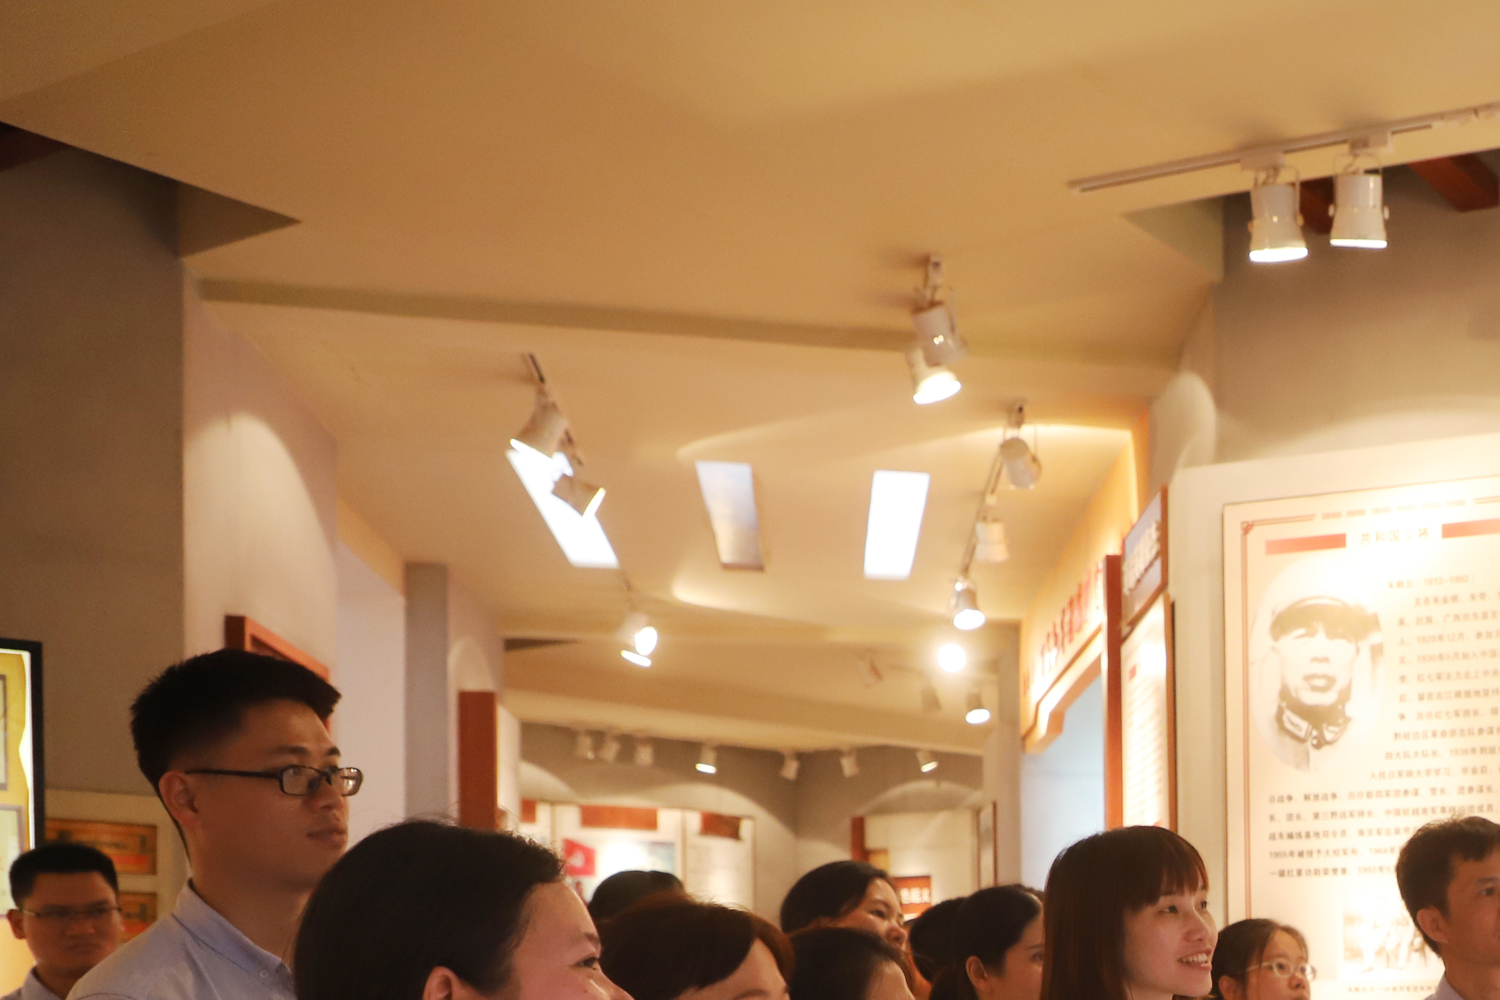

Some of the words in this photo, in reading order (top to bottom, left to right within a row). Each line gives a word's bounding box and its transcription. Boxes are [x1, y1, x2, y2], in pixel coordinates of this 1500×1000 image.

[1360, 527, 1429, 546] 共和国少将
